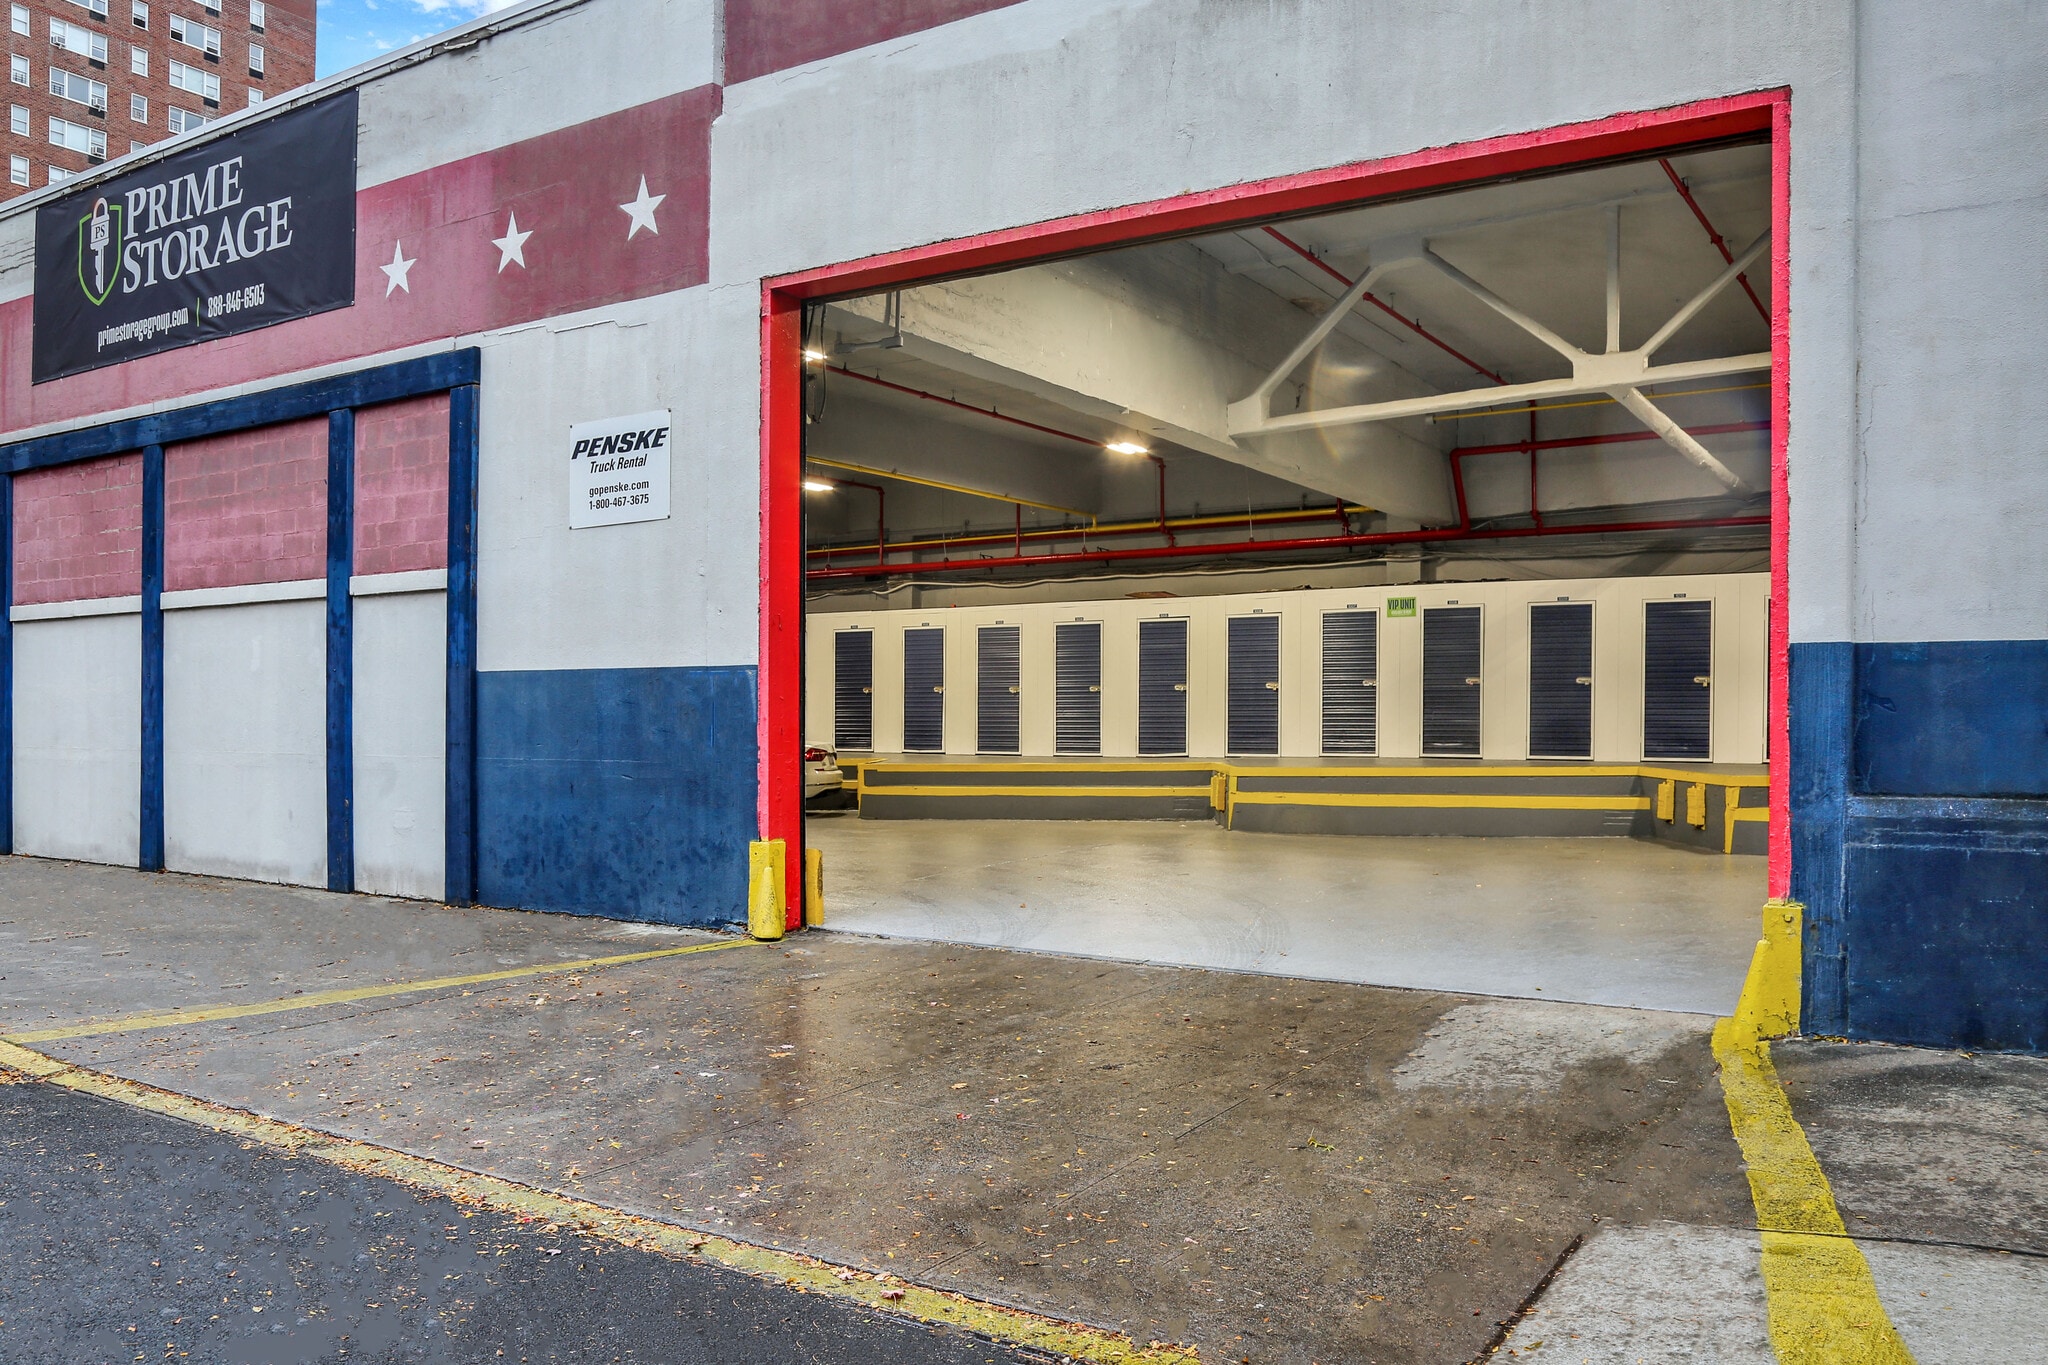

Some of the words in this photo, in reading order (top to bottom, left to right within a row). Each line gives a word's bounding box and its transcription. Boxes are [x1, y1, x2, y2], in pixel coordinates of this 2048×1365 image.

[124, 156, 244, 241] PRIME
[94, 224, 106, 240] PS
[123, 196, 293, 294] STORAGE
[98, 306, 189, 352] primestoragegroup.com
[207, 283, 265, 318] 888-846-6503
[571, 427, 669, 460] PENSKE
[590, 458, 616, 474] Truck
[617, 453, 648, 470] Rental
[589, 480, 649, 497] gopenske.com
[589, 493, 649, 510] 1-800-467-3675
[1387, 599, 1399, 610] VIP
[1400, 599, 1415, 609] UNIT
